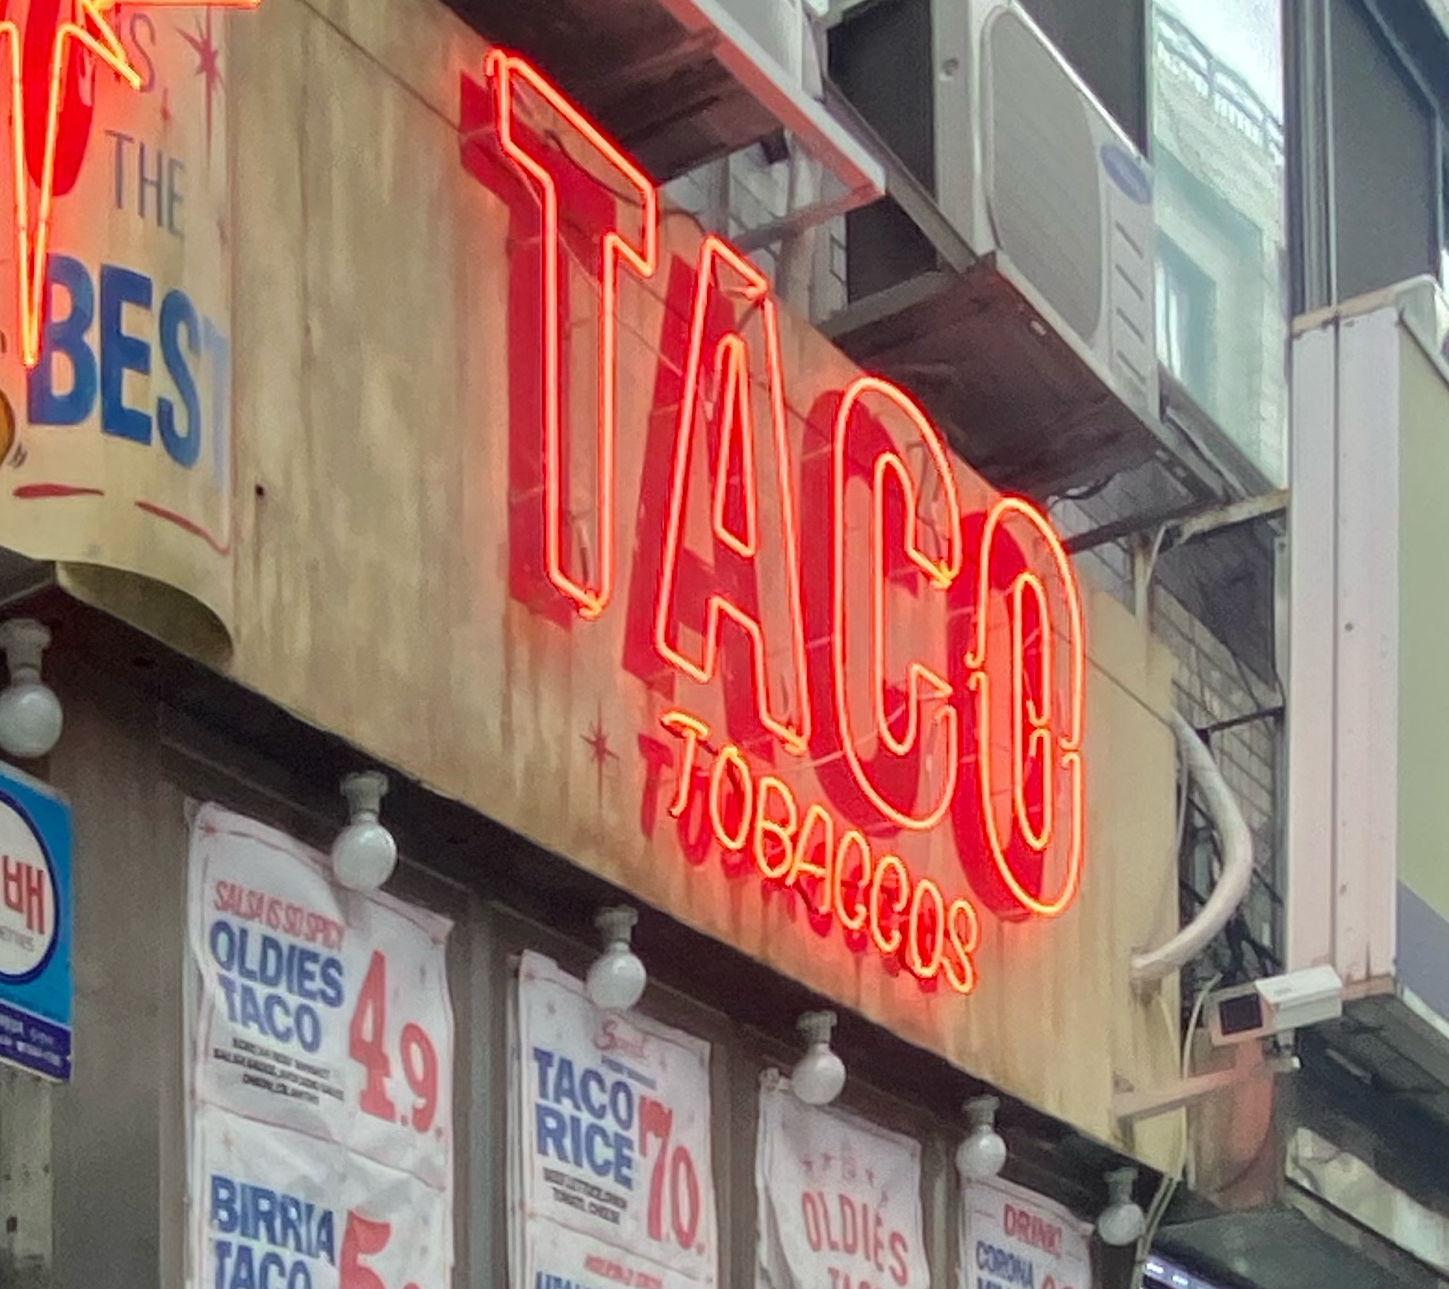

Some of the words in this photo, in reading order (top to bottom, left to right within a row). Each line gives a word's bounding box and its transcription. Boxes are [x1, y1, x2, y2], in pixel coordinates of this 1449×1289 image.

[105, 128, 186, 238] THE
[462, 49, 1086, 922] TACO
[658, 711, 980, 995] TOBACCOS
[210, 919, 344, 1008] OLDIES
[218, 973, 322, 1053] TACO
[534, 1046, 634, 1131] TACO
[535, 1102, 634, 1192] RICE
[210, 1174, 336, 1267] BIRRIA
[801, 1190, 910, 1287] OLDIES
